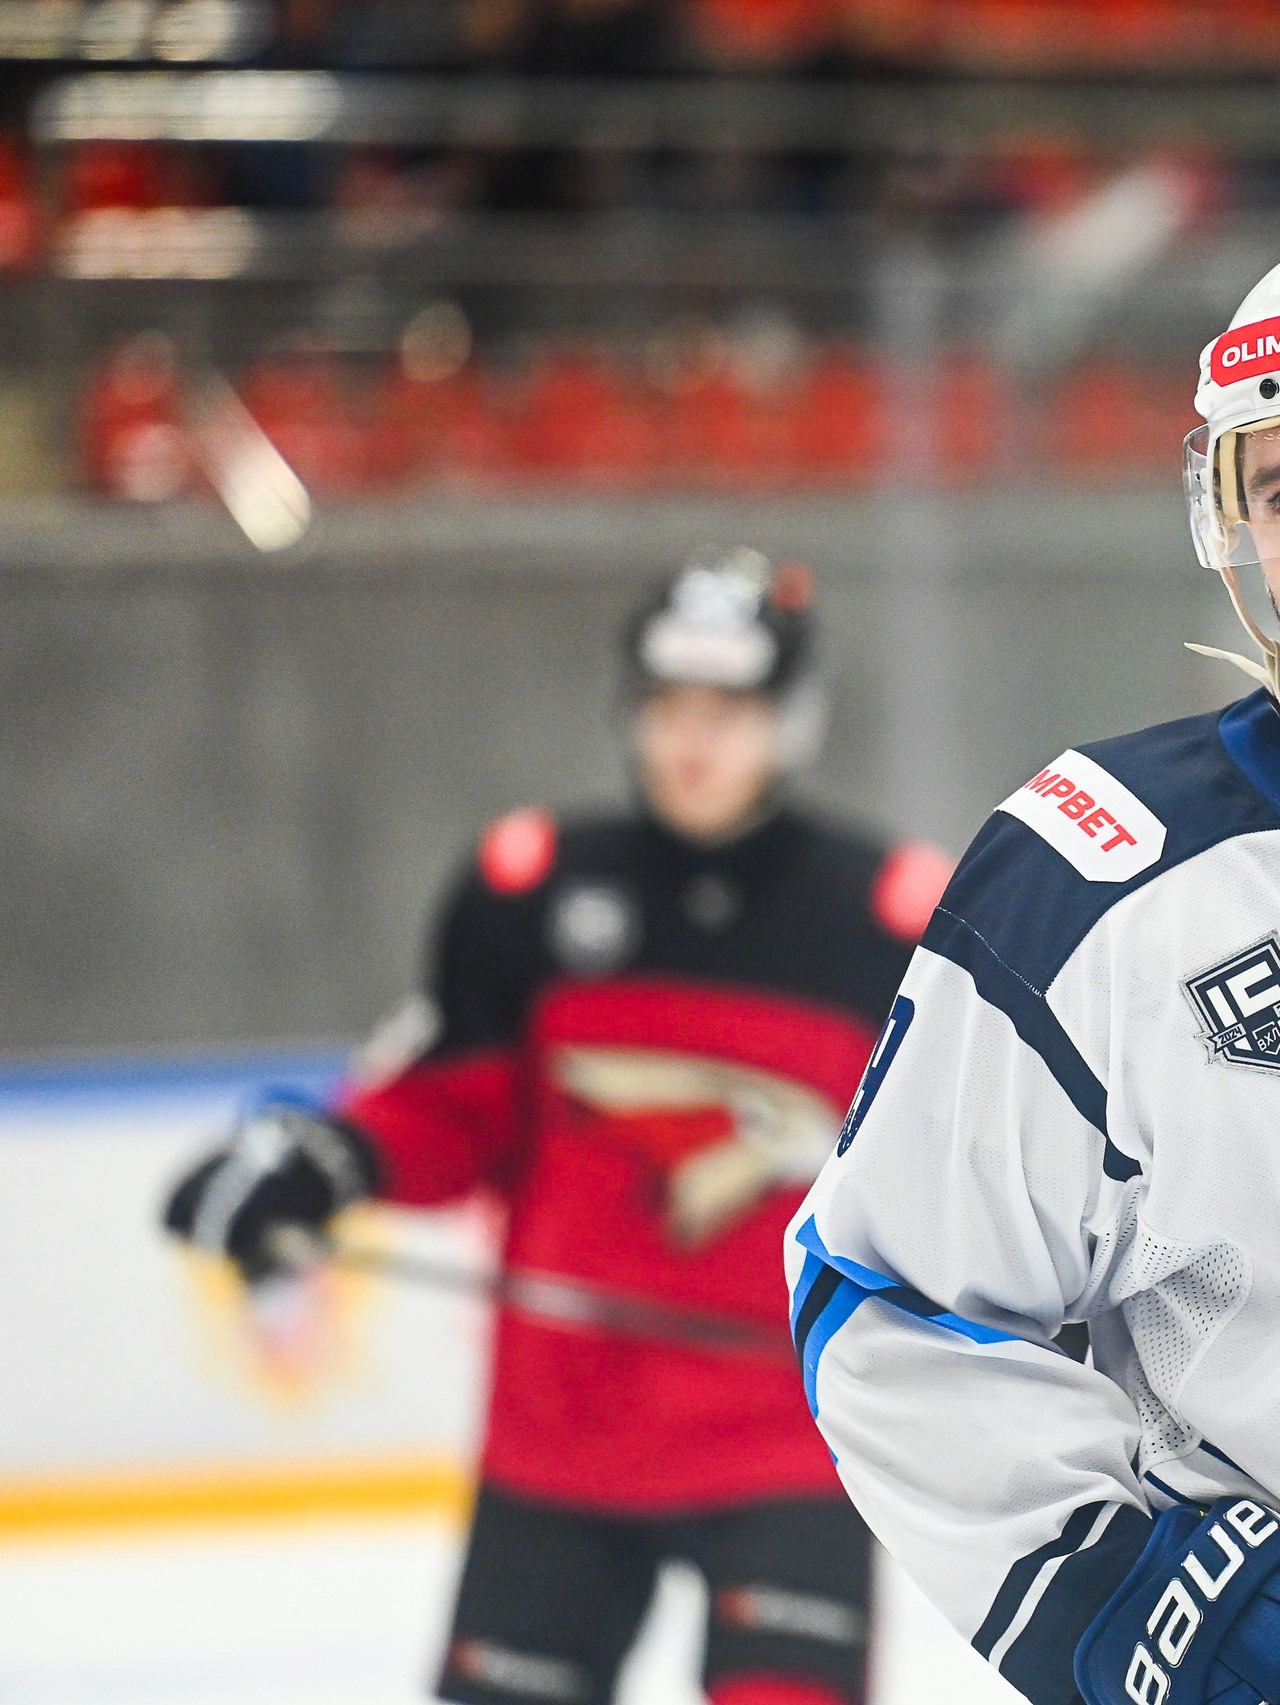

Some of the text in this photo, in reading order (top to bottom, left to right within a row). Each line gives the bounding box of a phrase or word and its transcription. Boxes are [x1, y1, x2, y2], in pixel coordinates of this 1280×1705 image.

[1024, 769, 1137, 852] MPBET
[1218, 1026, 1243, 1044] 2024
[1256, 1027, 1280, 1051] ВХЛ
